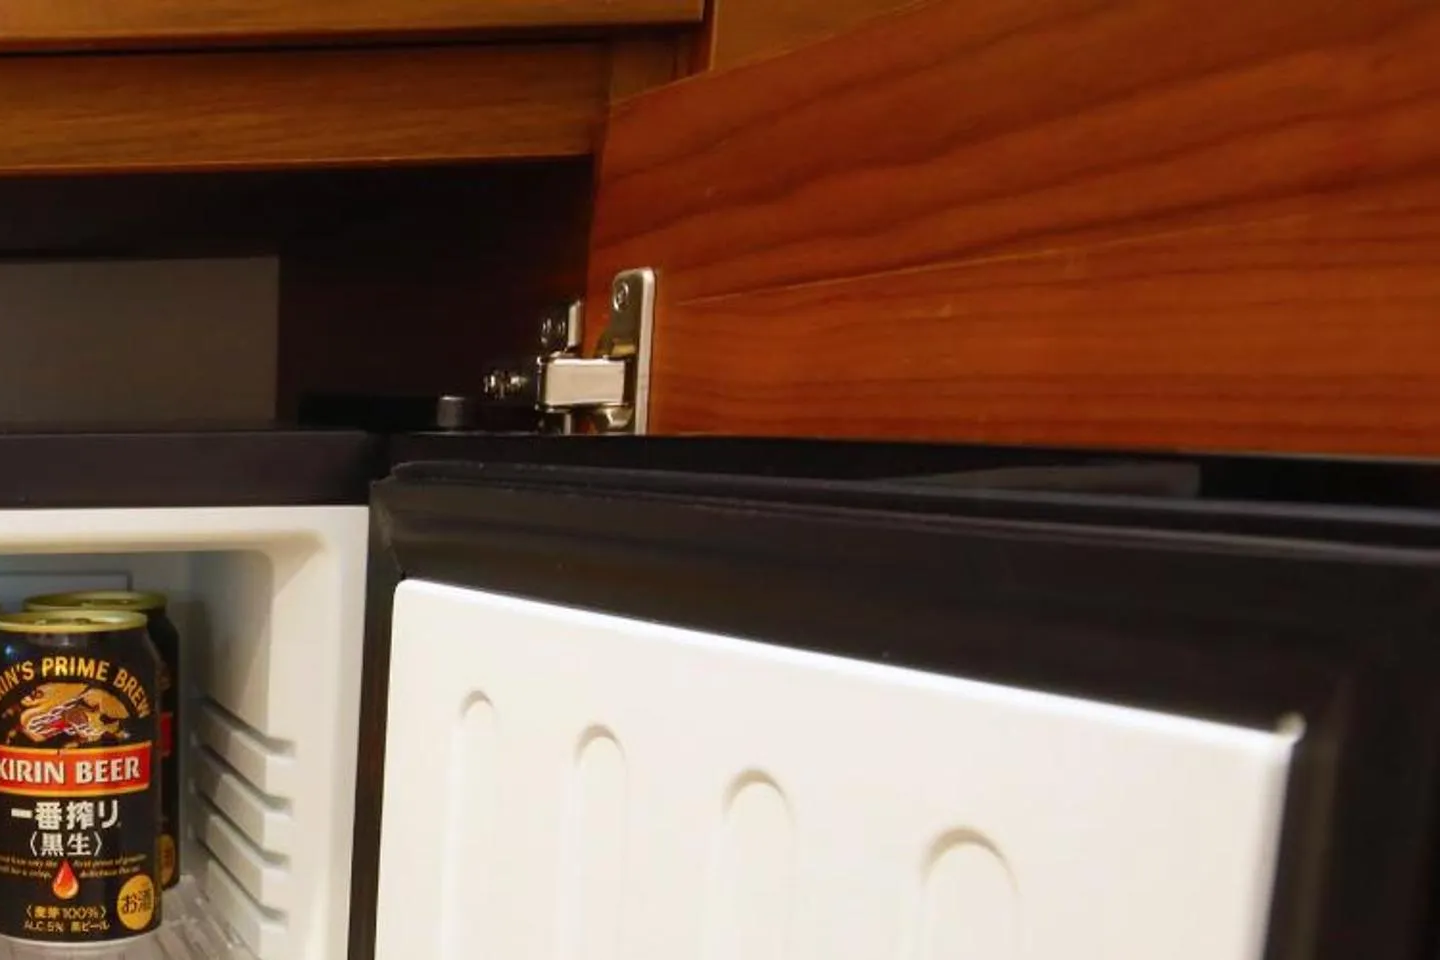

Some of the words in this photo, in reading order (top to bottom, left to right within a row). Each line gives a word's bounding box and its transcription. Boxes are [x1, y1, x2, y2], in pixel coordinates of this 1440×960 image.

[41, 656, 110, 682] PRIME
[112, 668, 151, 718] BREW
[75, 756, 141, 784] BEER
[11, 800, 119, 830] 一番搾り
